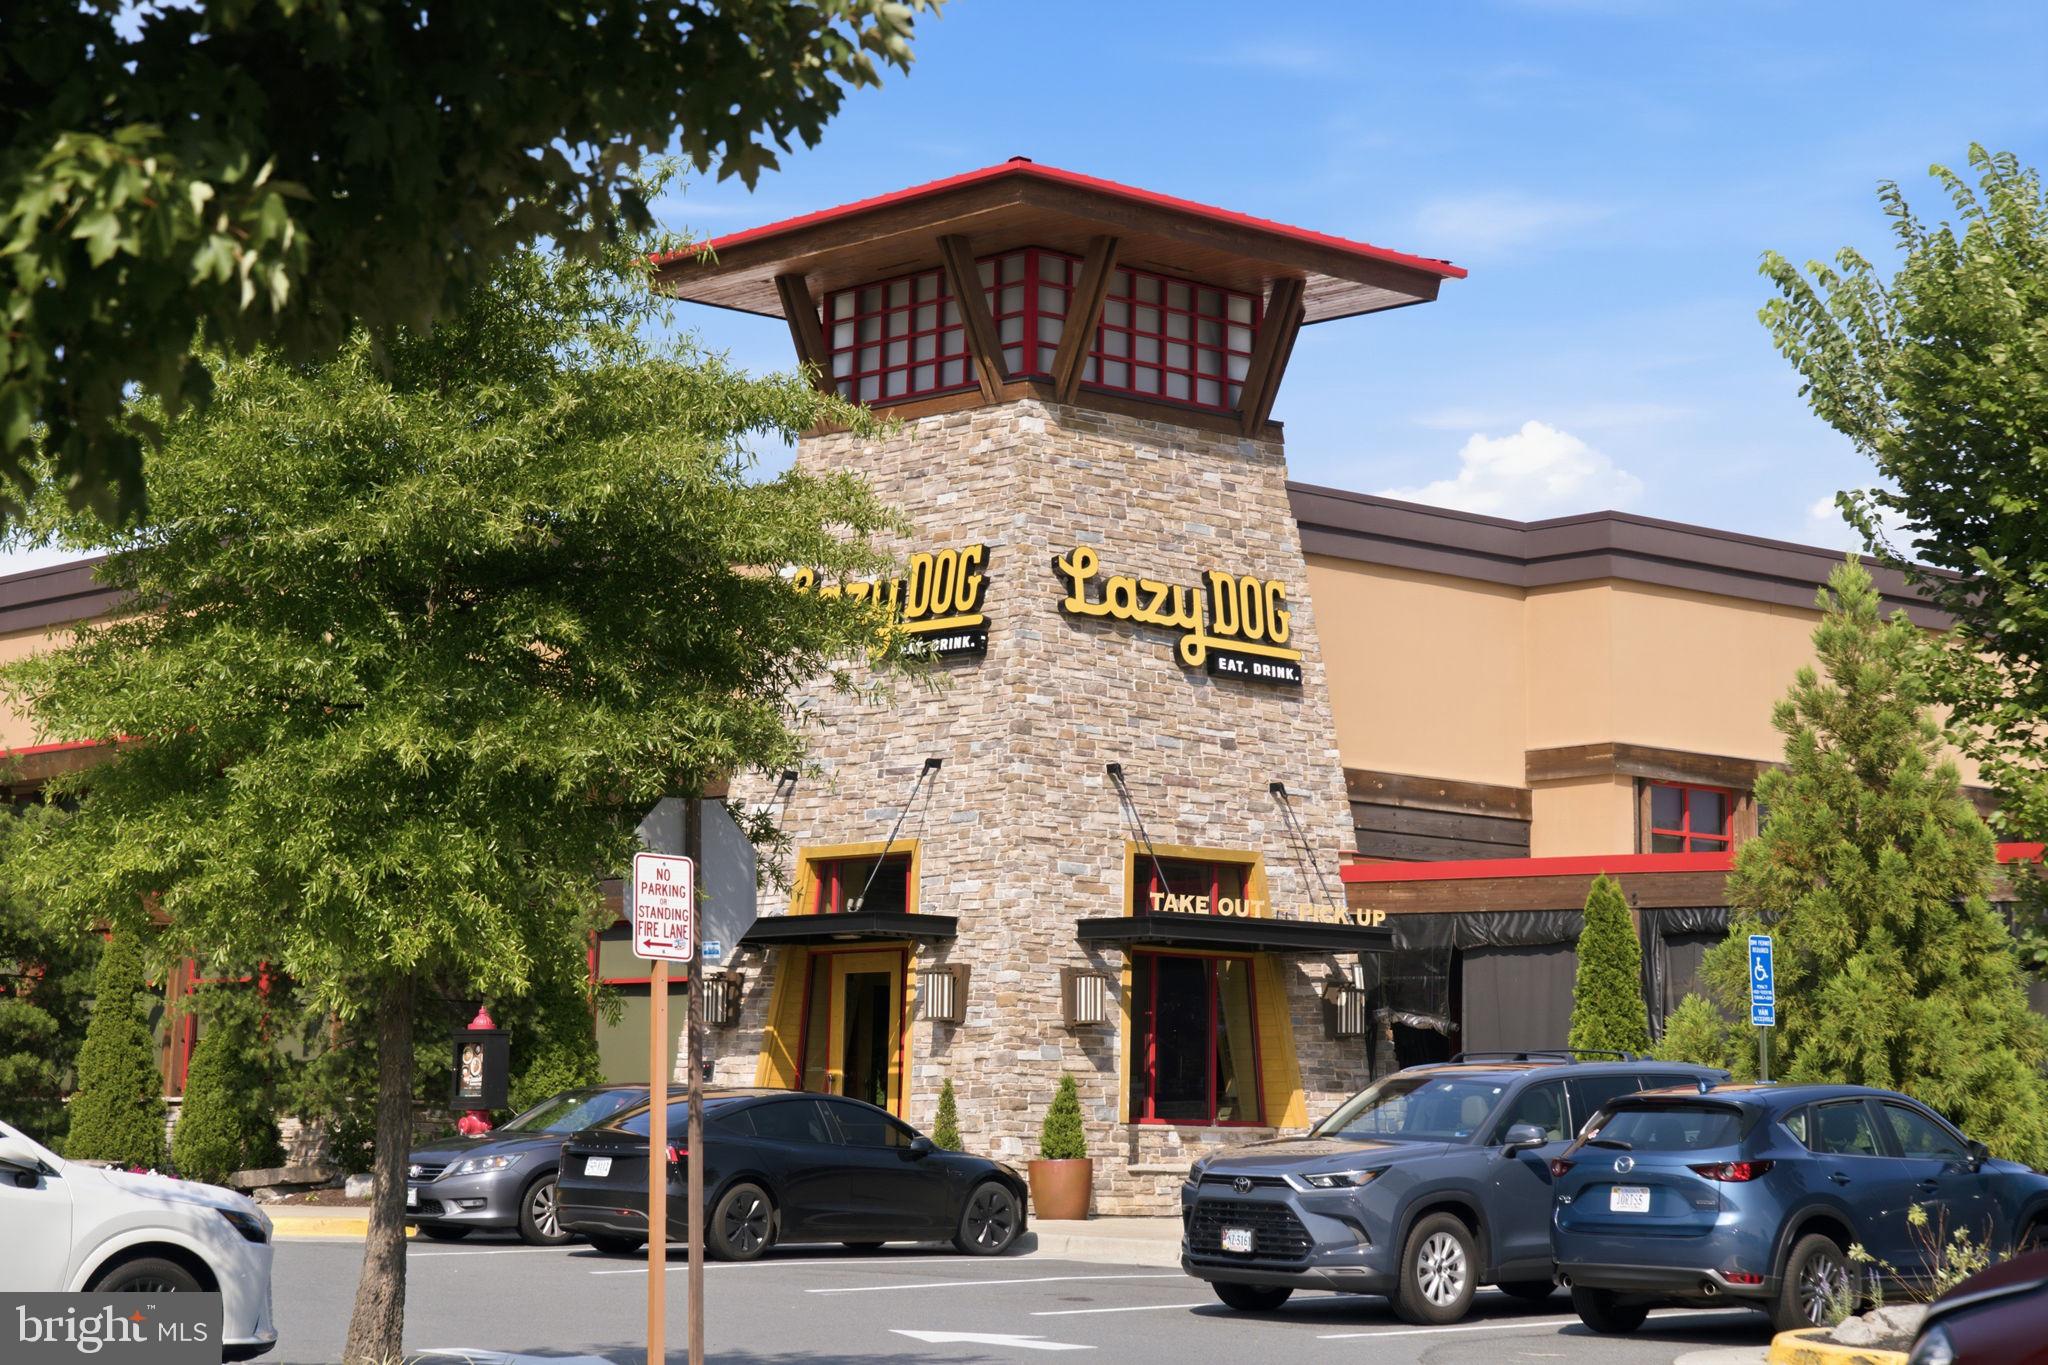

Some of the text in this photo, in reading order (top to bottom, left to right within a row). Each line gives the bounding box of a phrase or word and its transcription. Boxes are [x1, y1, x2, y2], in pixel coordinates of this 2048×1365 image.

[904, 544, 983, 618] DOG
[1056, 545, 1291, 667] Lazy DOG
[1218, 657, 1300, 681] EAT. DRINK.
[656, 867, 671, 882] NO
[641, 881, 686, 898] PARKING
[638, 905, 689, 922] STANDING
[1150, 892, 1386, 927] TAKE OUT PICK UP
[638, 920, 689, 940] FIRE LANE
